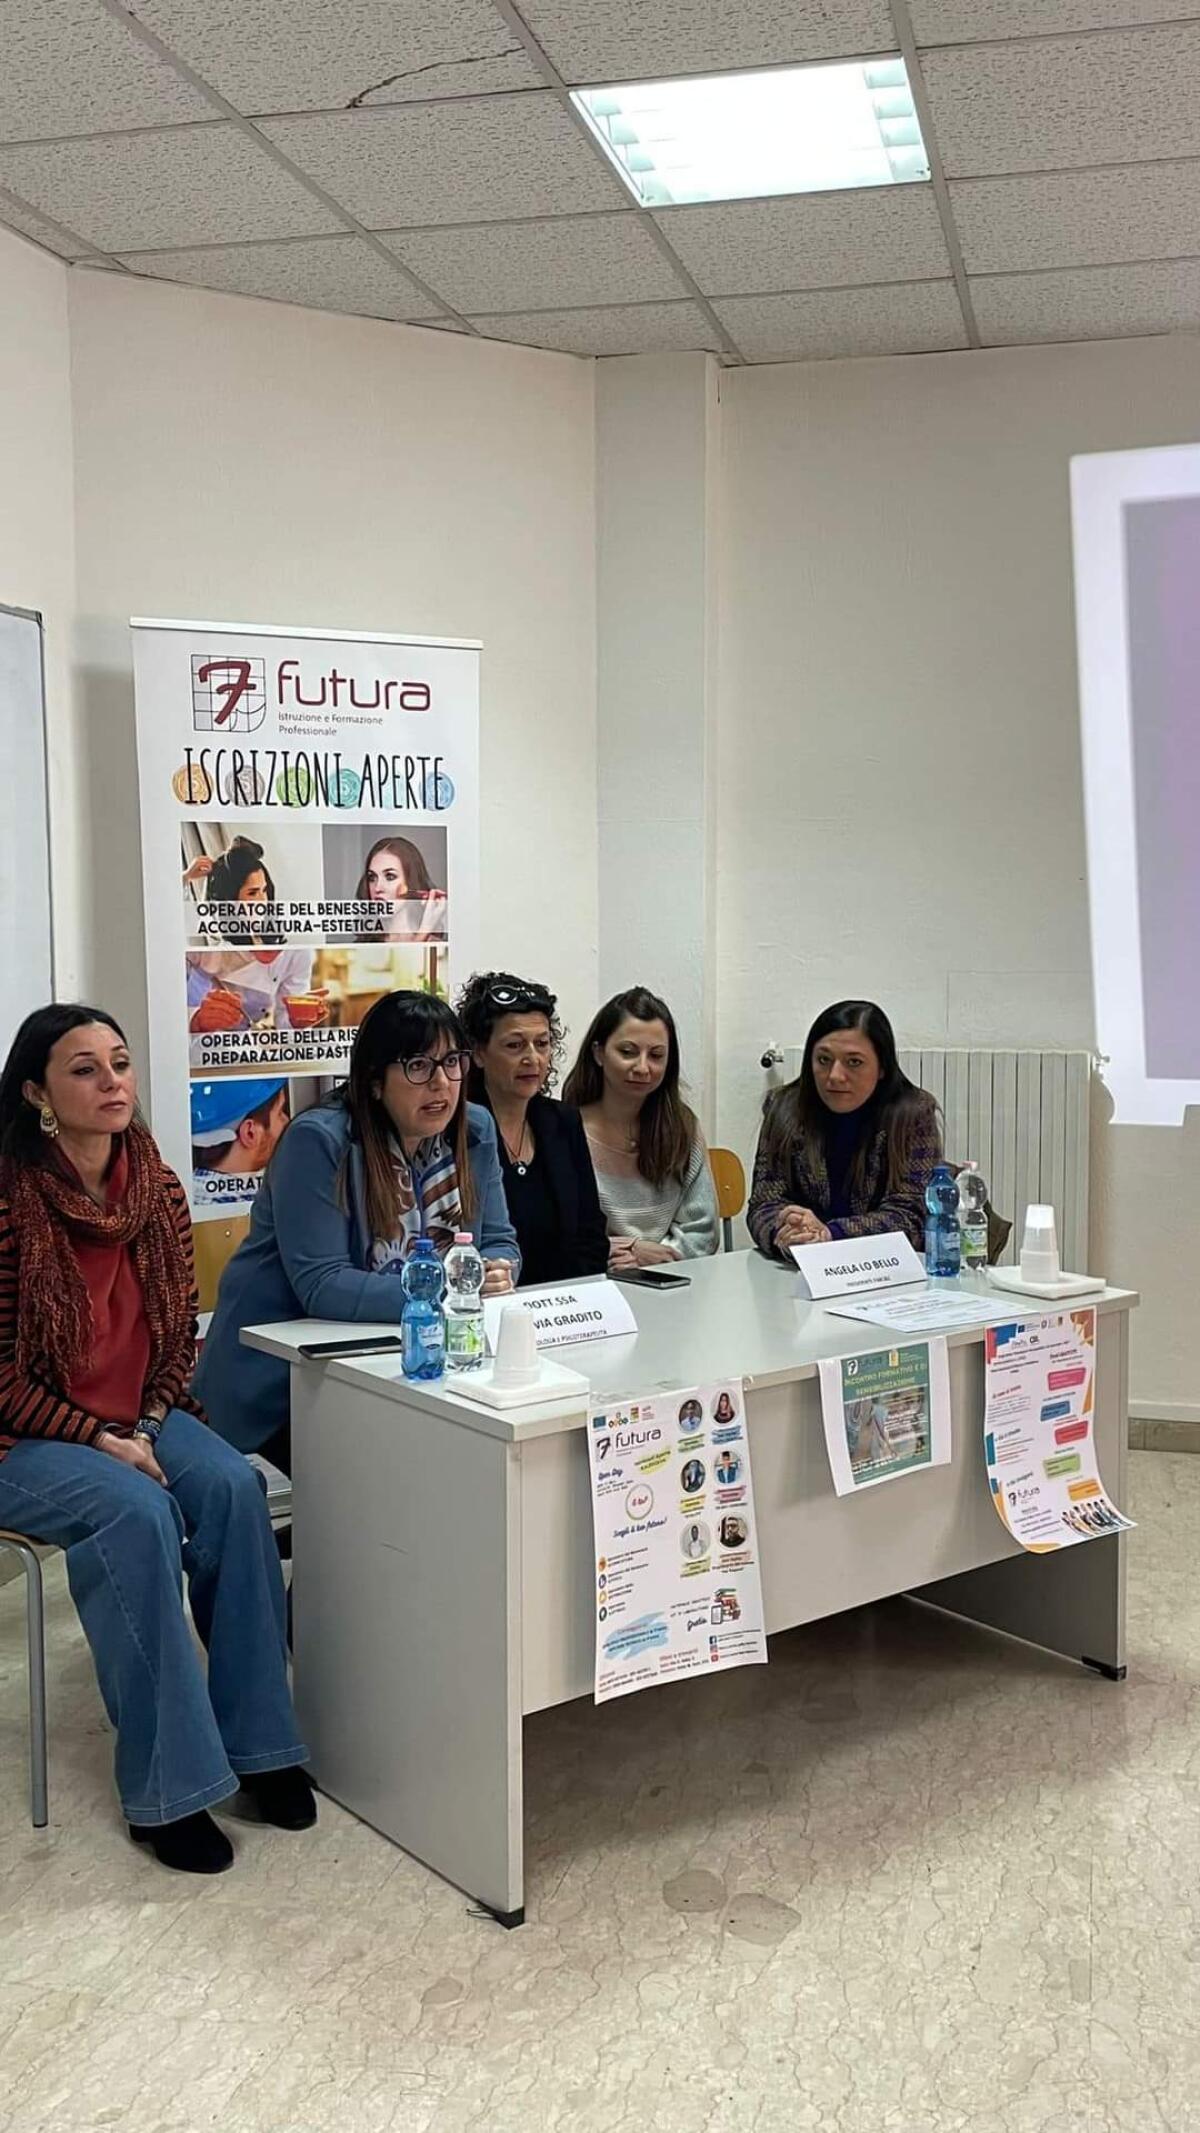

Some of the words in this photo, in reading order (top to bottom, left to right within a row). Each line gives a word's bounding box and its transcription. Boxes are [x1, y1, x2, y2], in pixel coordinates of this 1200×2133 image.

[277, 660, 431, 712] futura
[278, 711, 322, 722] Istruzione
[331, 714, 383, 725] Formazione
[278, 725, 338, 736] Professionale
[183, 747, 344, 808] ISCRIZIONI
[359, 753, 446, 811] APERTE
[197, 902, 285, 917] OPERATORE
[290, 902, 316, 916] DEL
[318, 901, 395, 916] BENESSERE
[197, 918, 385, 935] ACCONCIATURA-ESTETICA
[201, 1031, 289, 1048] OPERATORE
[294, 1029, 335, 1044] DELLA
[202, 1048, 315, 1066] PREPARAZIONE
[823, 1263, 860, 1278] ANGELA
[860, 1261, 873, 1272] LO
[872, 1256, 901, 1270] BELLO
[553, 1310, 603, 1327] GRADITO
[615, 1428, 662, 1449] futura
